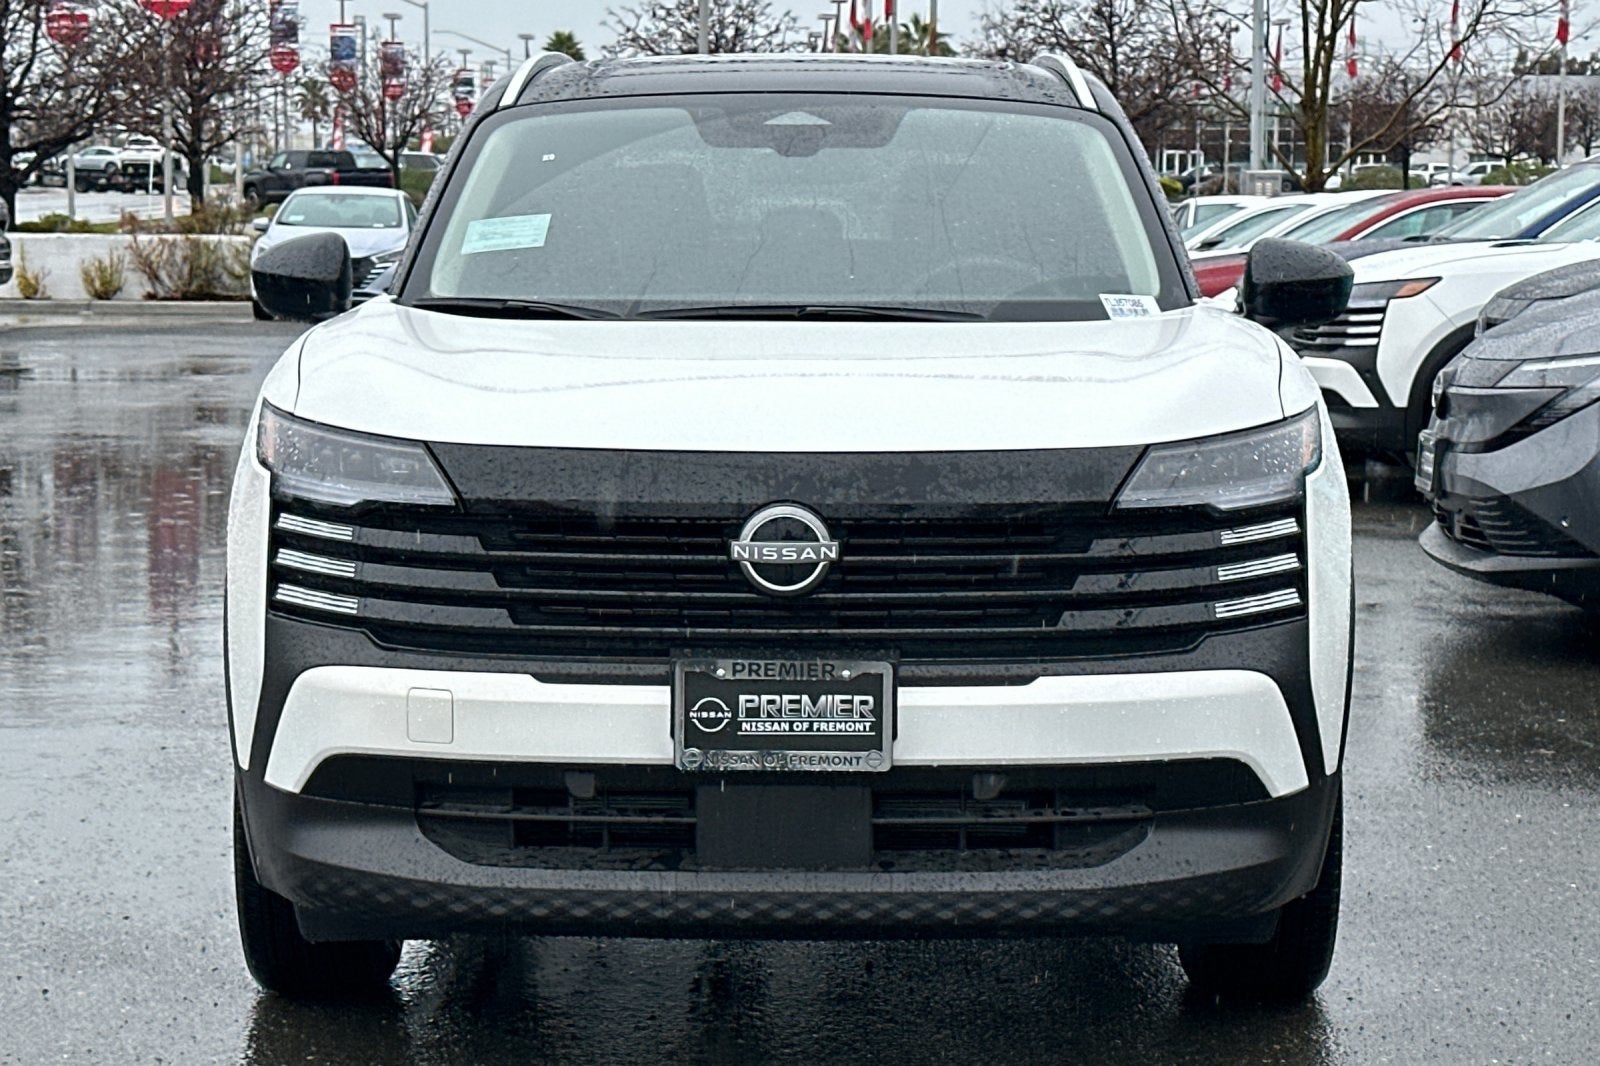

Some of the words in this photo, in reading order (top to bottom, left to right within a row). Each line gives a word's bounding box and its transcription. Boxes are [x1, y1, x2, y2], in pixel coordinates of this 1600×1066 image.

[733, 545, 836, 560] NISSAN
[732, 662, 836, 678] PREMIER
[738, 694, 876, 719] PREMIER
[689, 711, 732, 719] NISSAN
[741, 721, 790, 732] NISSAN
[793, 721, 809, 732] OF
[813, 721, 872, 732] FREMONT
[705, 753, 761, 767] NISSAN
[764, 754, 785, 767] OF
[789, 755, 863, 767] FREMONT
